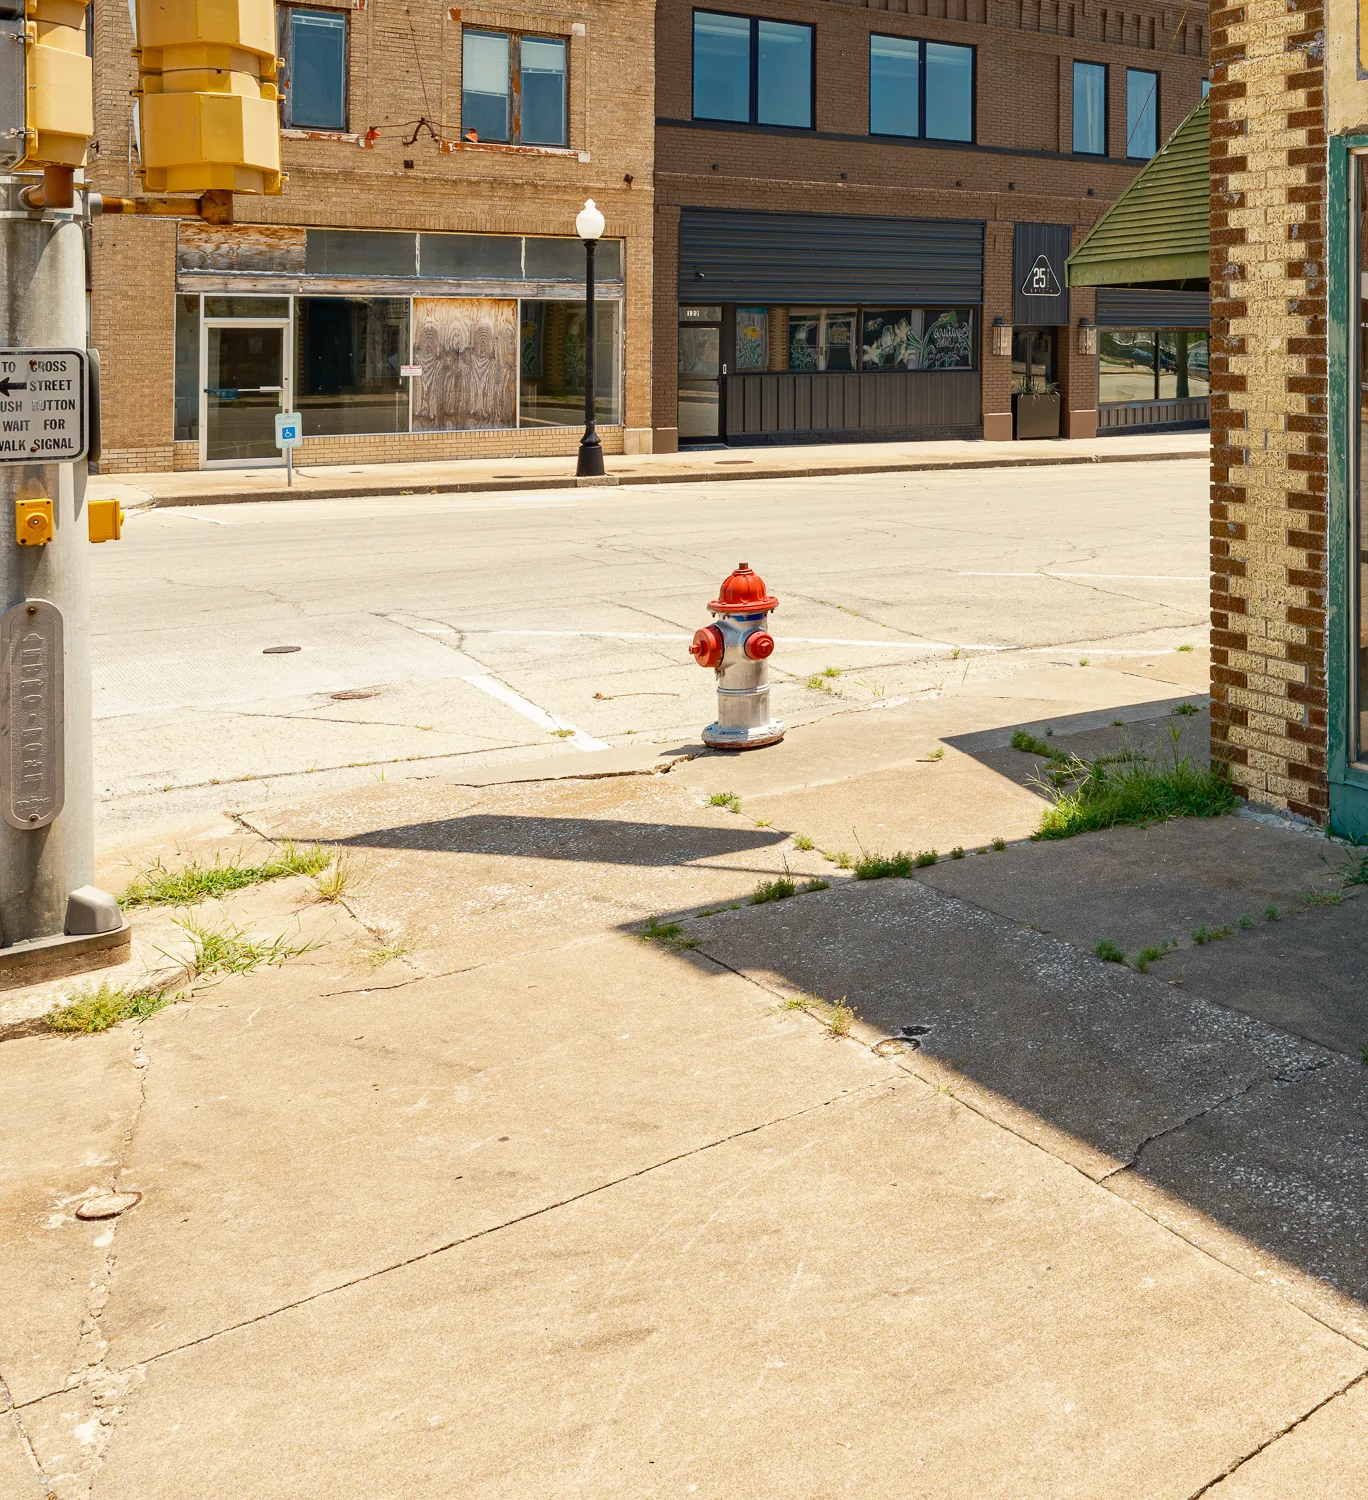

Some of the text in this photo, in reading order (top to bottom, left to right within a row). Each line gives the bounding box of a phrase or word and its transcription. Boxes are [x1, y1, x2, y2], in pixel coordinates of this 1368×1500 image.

[1033, 267, 1046, 288] 25
[2, 360, 67, 373] TO CROSS
[30, 379, 72, 392] STREET
[0, 399, 76, 412] USH BUTTON
[3, 418, 65, 431] WAIT FOR
[33, 438, 74, 450] SIGNAL
